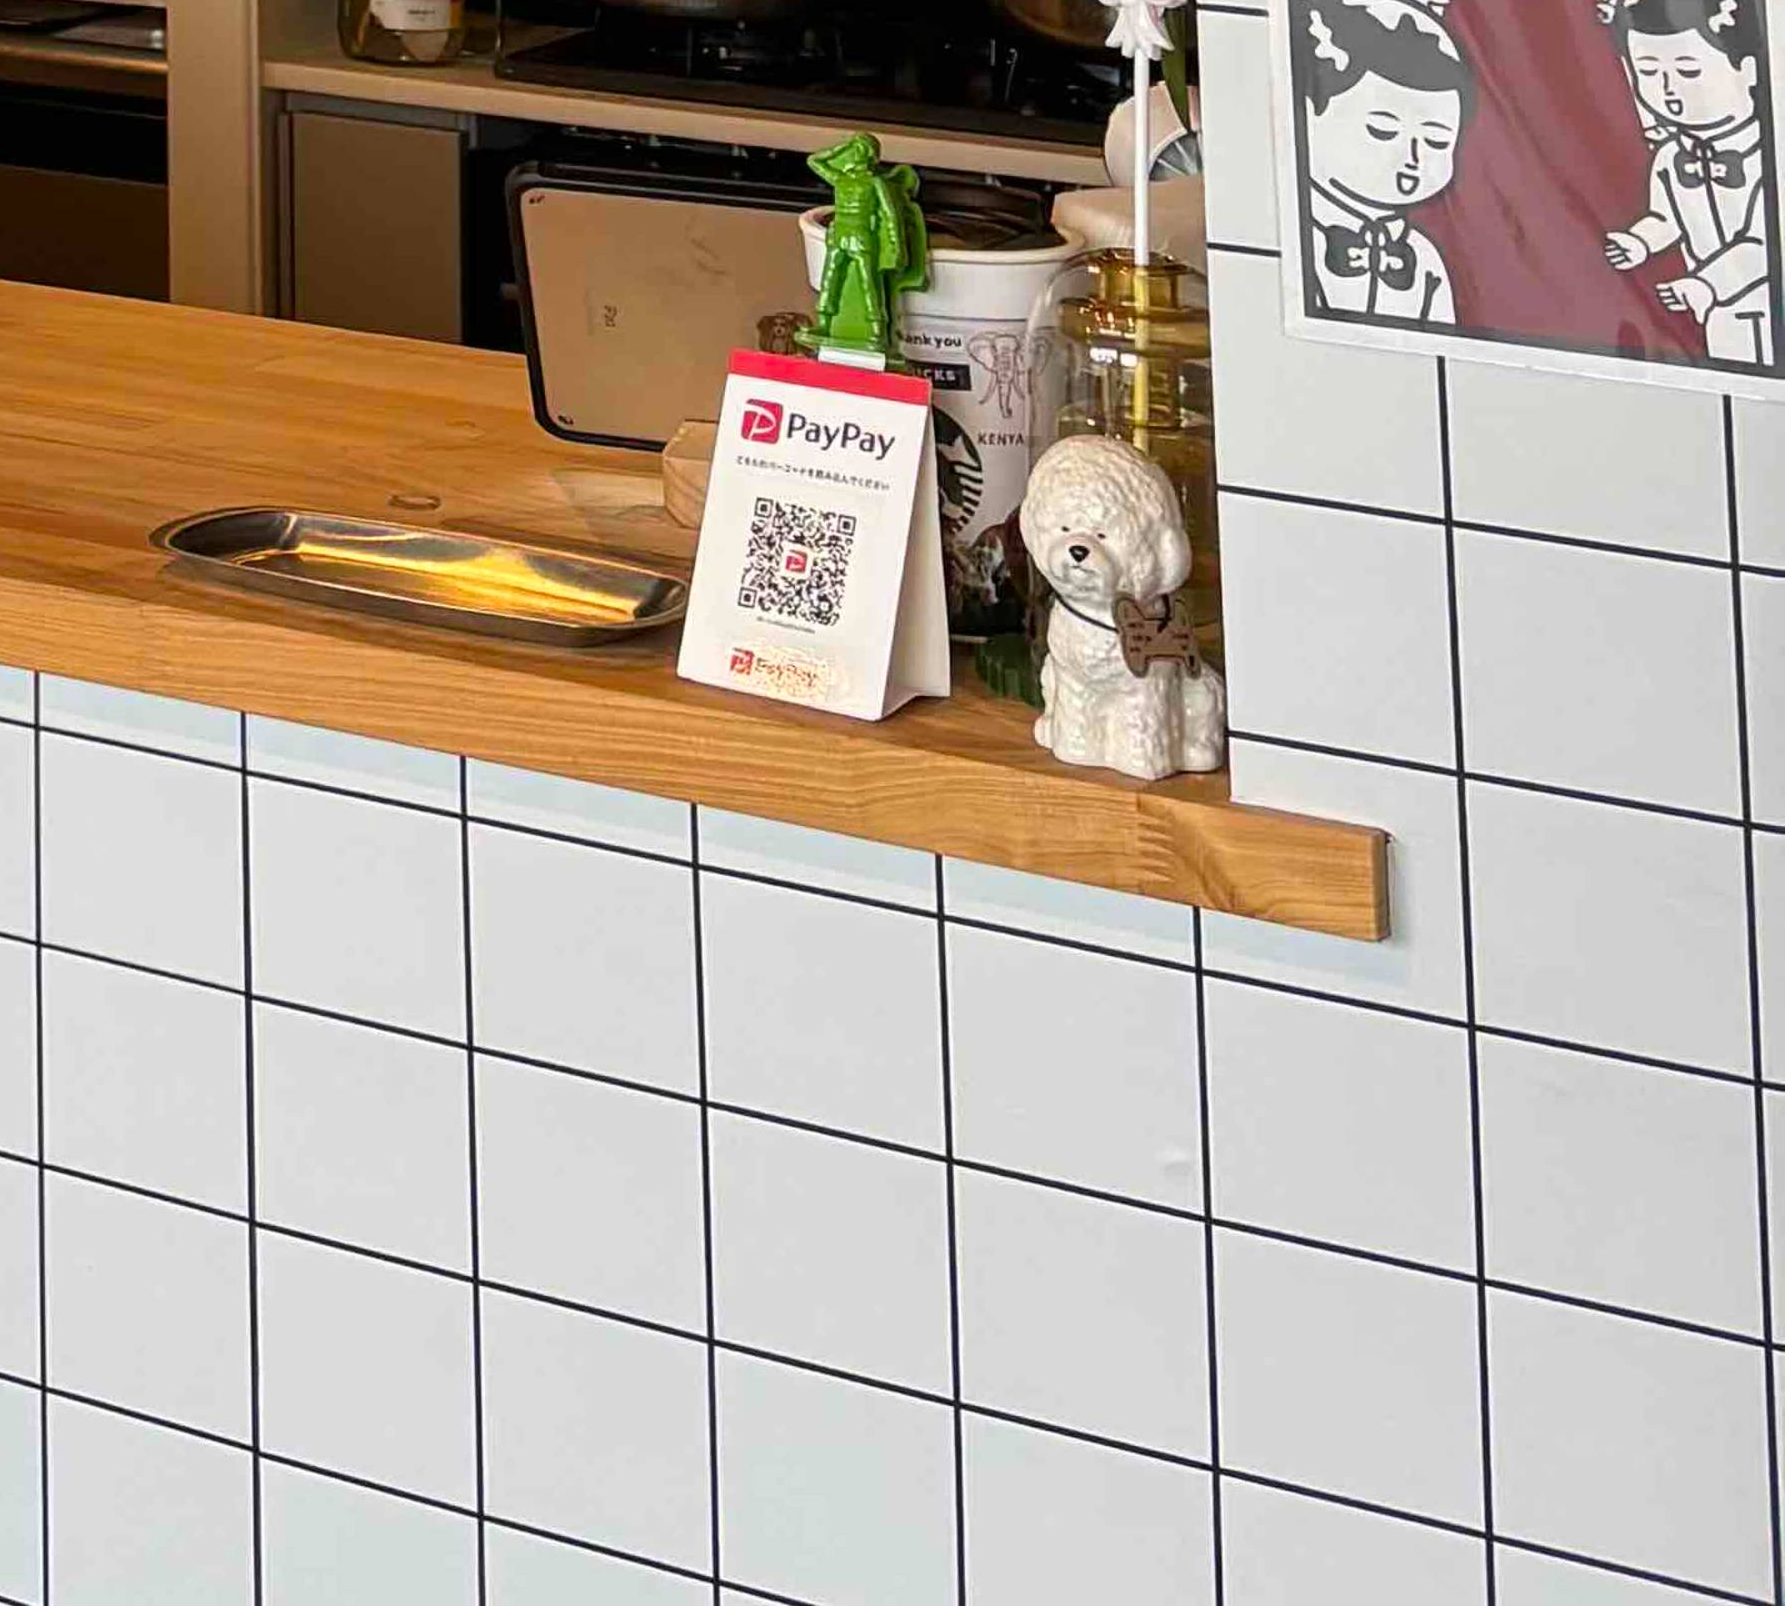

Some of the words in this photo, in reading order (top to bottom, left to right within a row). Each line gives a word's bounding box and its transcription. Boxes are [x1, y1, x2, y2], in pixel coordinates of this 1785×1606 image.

[935, 337, 961, 348] you
[787, 412, 895, 461] PayPay
[978, 433, 1024, 446] KENYA
